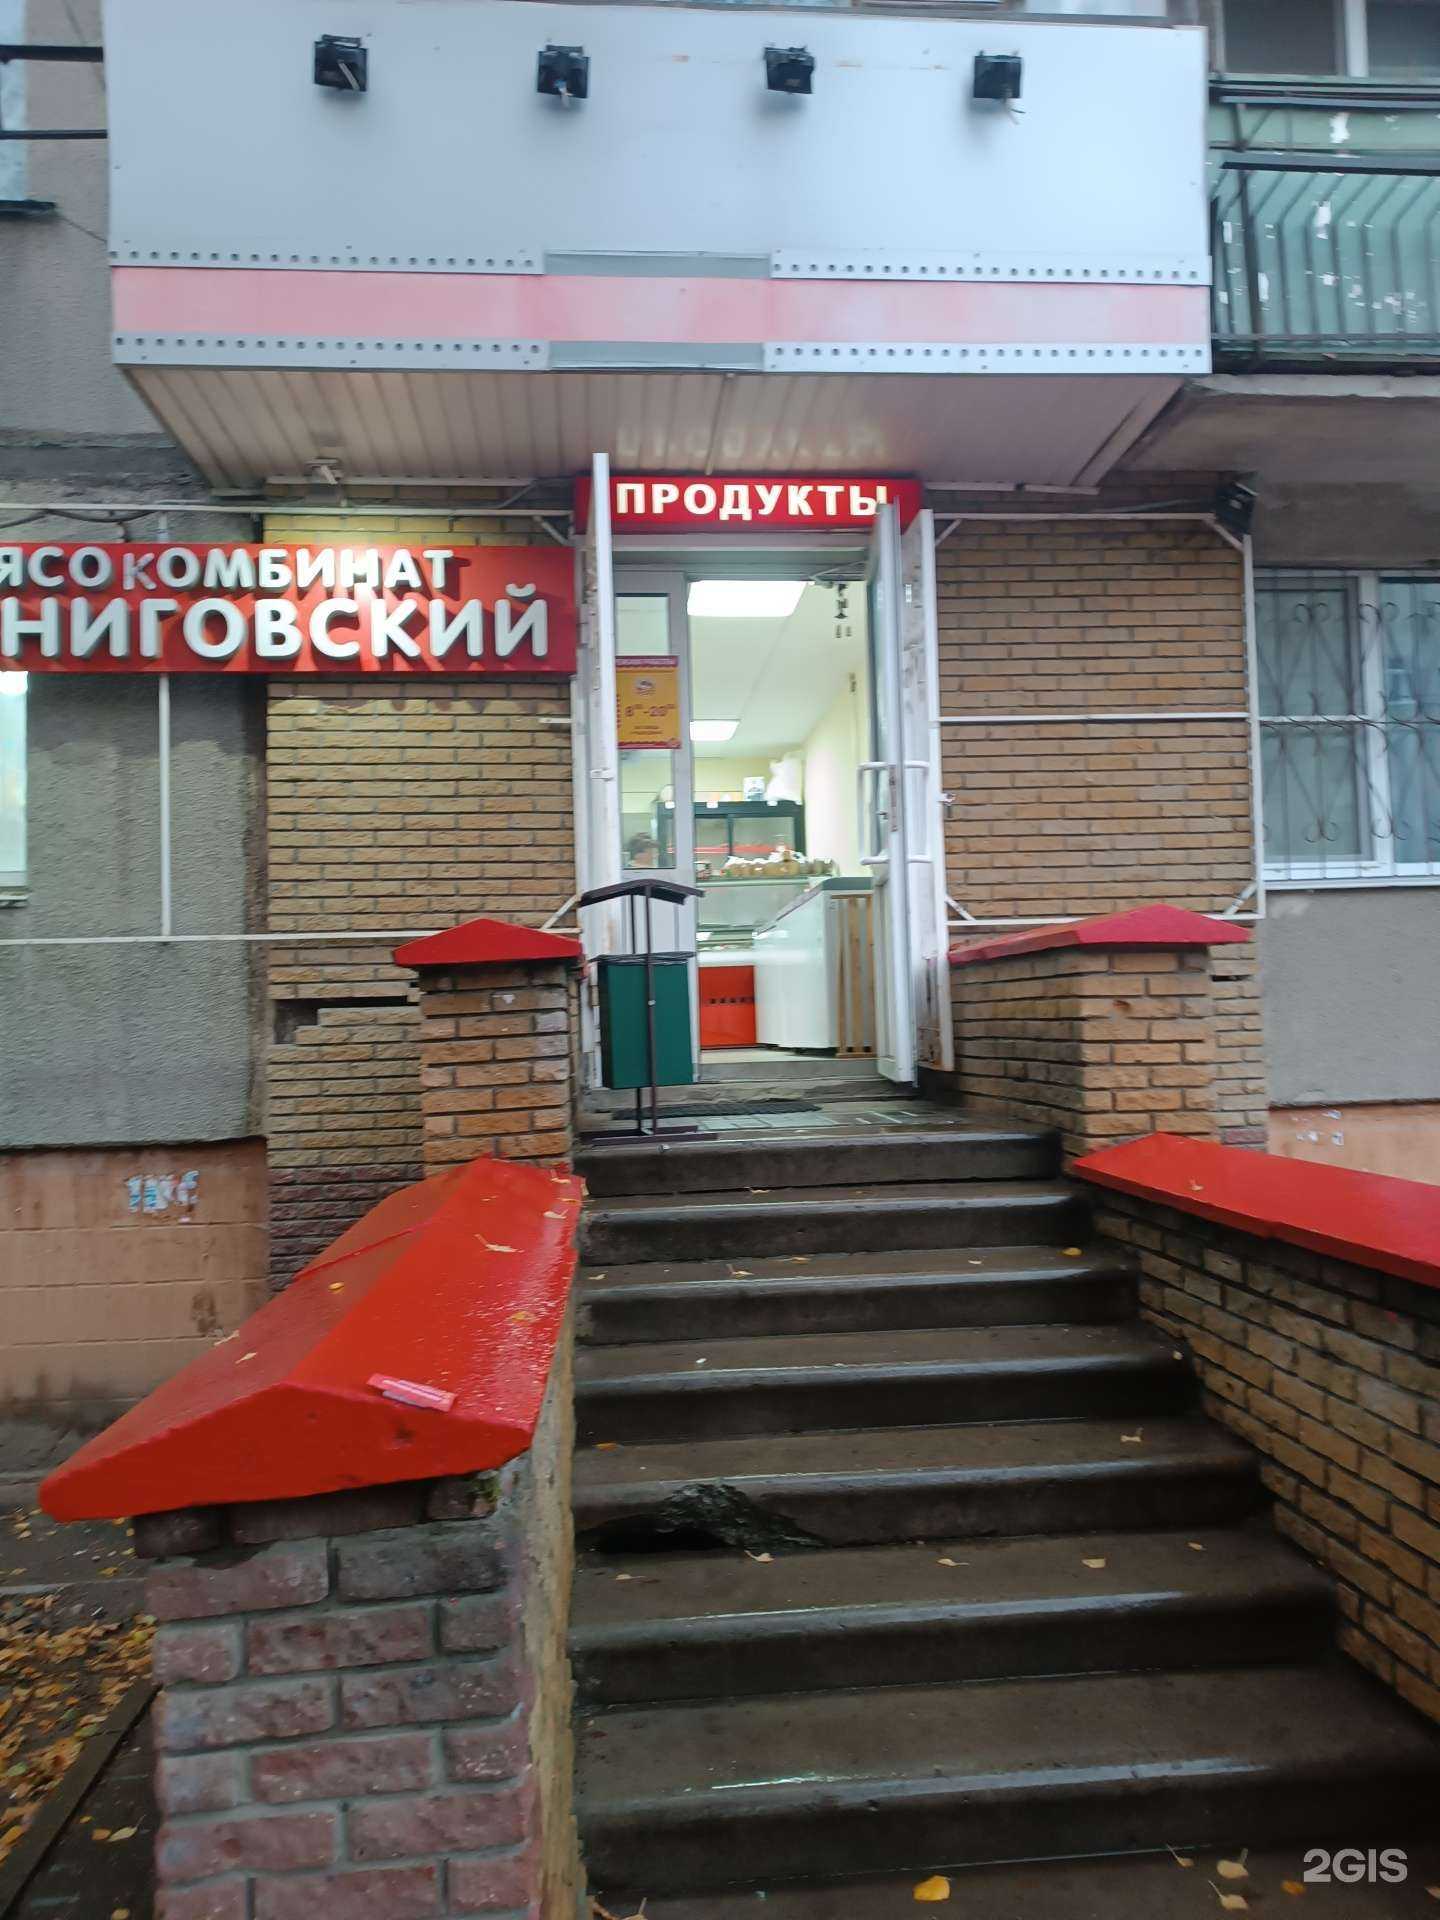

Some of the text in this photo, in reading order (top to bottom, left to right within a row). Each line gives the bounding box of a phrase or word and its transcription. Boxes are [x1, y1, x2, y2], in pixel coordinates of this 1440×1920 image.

[616, 483, 887, 520] ПРОДУКТЫ
[0, 546, 454, 590] ЯСОКОМБИНАТ
[2, 583, 548, 658] НИГОВСКИЙ
